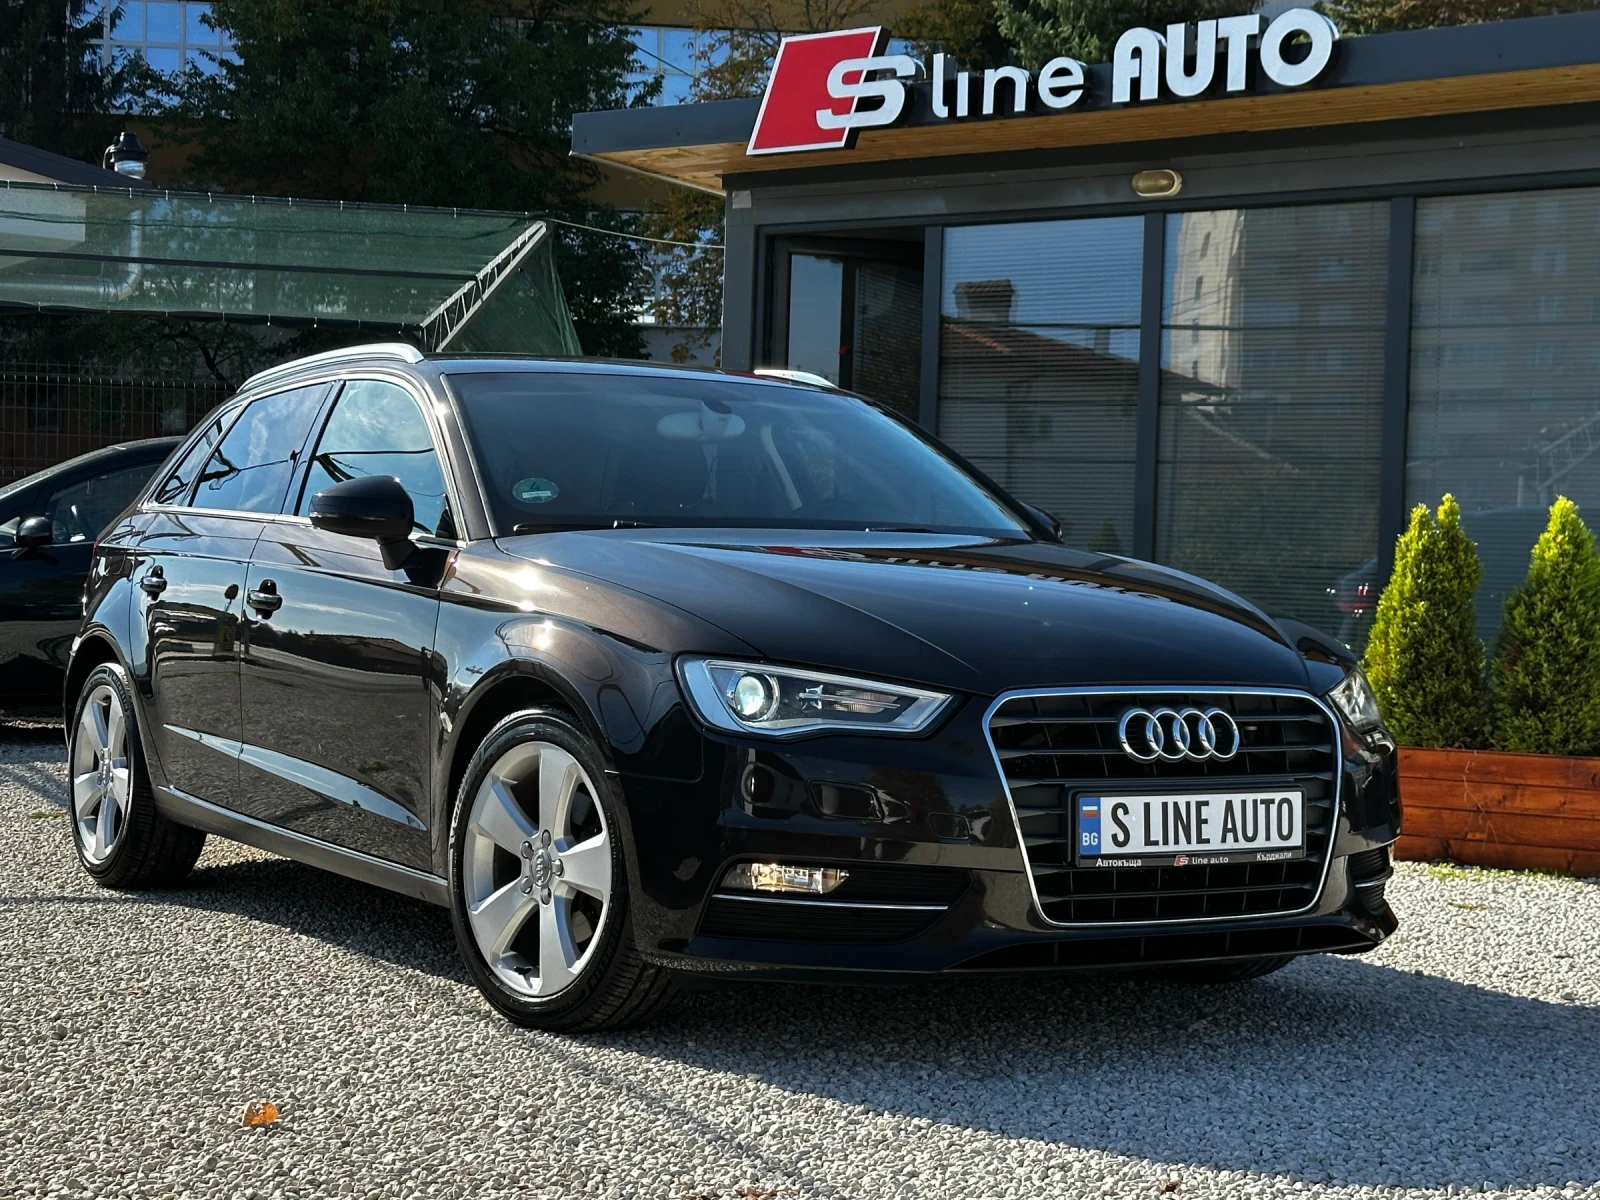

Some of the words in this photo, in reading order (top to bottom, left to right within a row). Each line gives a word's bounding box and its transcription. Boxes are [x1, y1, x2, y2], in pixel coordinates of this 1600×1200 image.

[816, 55, 916, 130] S
[932, 52, 1085, 118] line
[1112, 8, 1333, 103] AUTO
[530, 481, 540, 491] 4
[1111, 802, 1131, 848] S
[1143, 800, 1211, 847] LINE
[1220, 797, 1294, 844] AUTO
[1082, 832, 1099, 846] BG
[1192, 857, 1208, 865] line
[1210, 856, 1229, 864] auto
[1256, 851, 1292, 862] Кърджали
[1095, 858, 1142, 867] Автокъща
